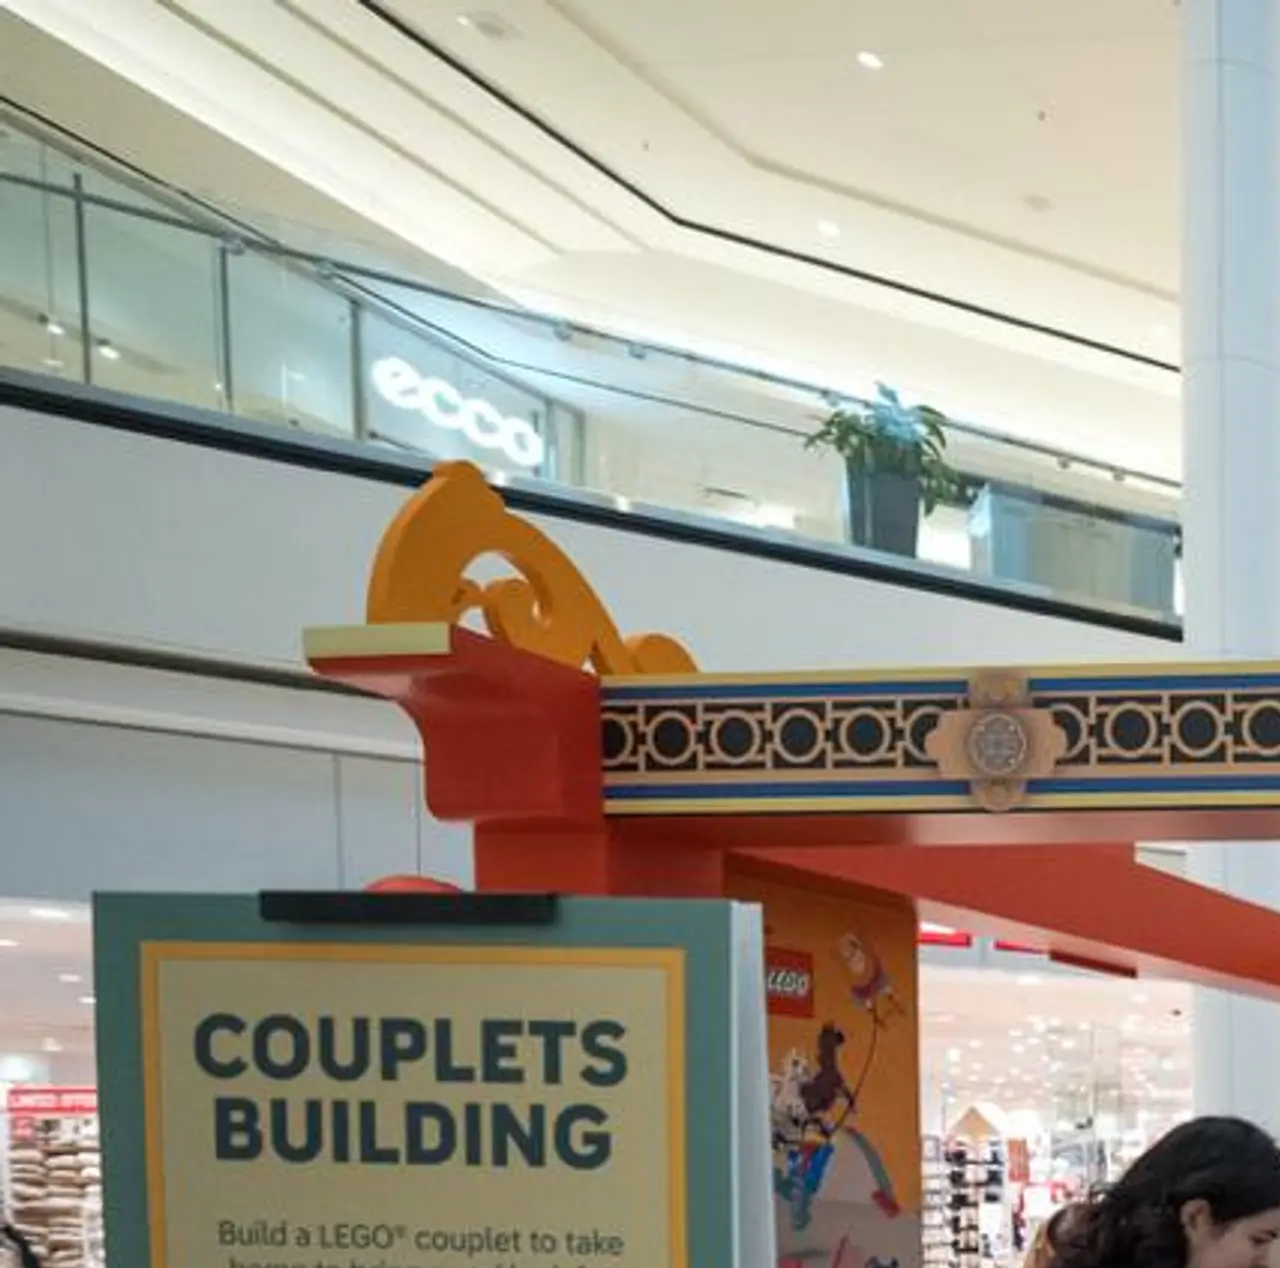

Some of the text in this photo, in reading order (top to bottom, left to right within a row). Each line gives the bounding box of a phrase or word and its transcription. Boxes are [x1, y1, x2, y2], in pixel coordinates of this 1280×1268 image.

[372, 357, 543, 466] ecco
[194, 1013, 627, 1086] COUPLETS
[214, 1097, 610, 1169] BUILDING
[218, 1220, 287, 1246] Build
[295, 1227, 310, 1247] a
[415, 1227, 521, 1258] couplet
[529, 1231, 557, 1254] to
[566, 1229, 624, 1256] take
